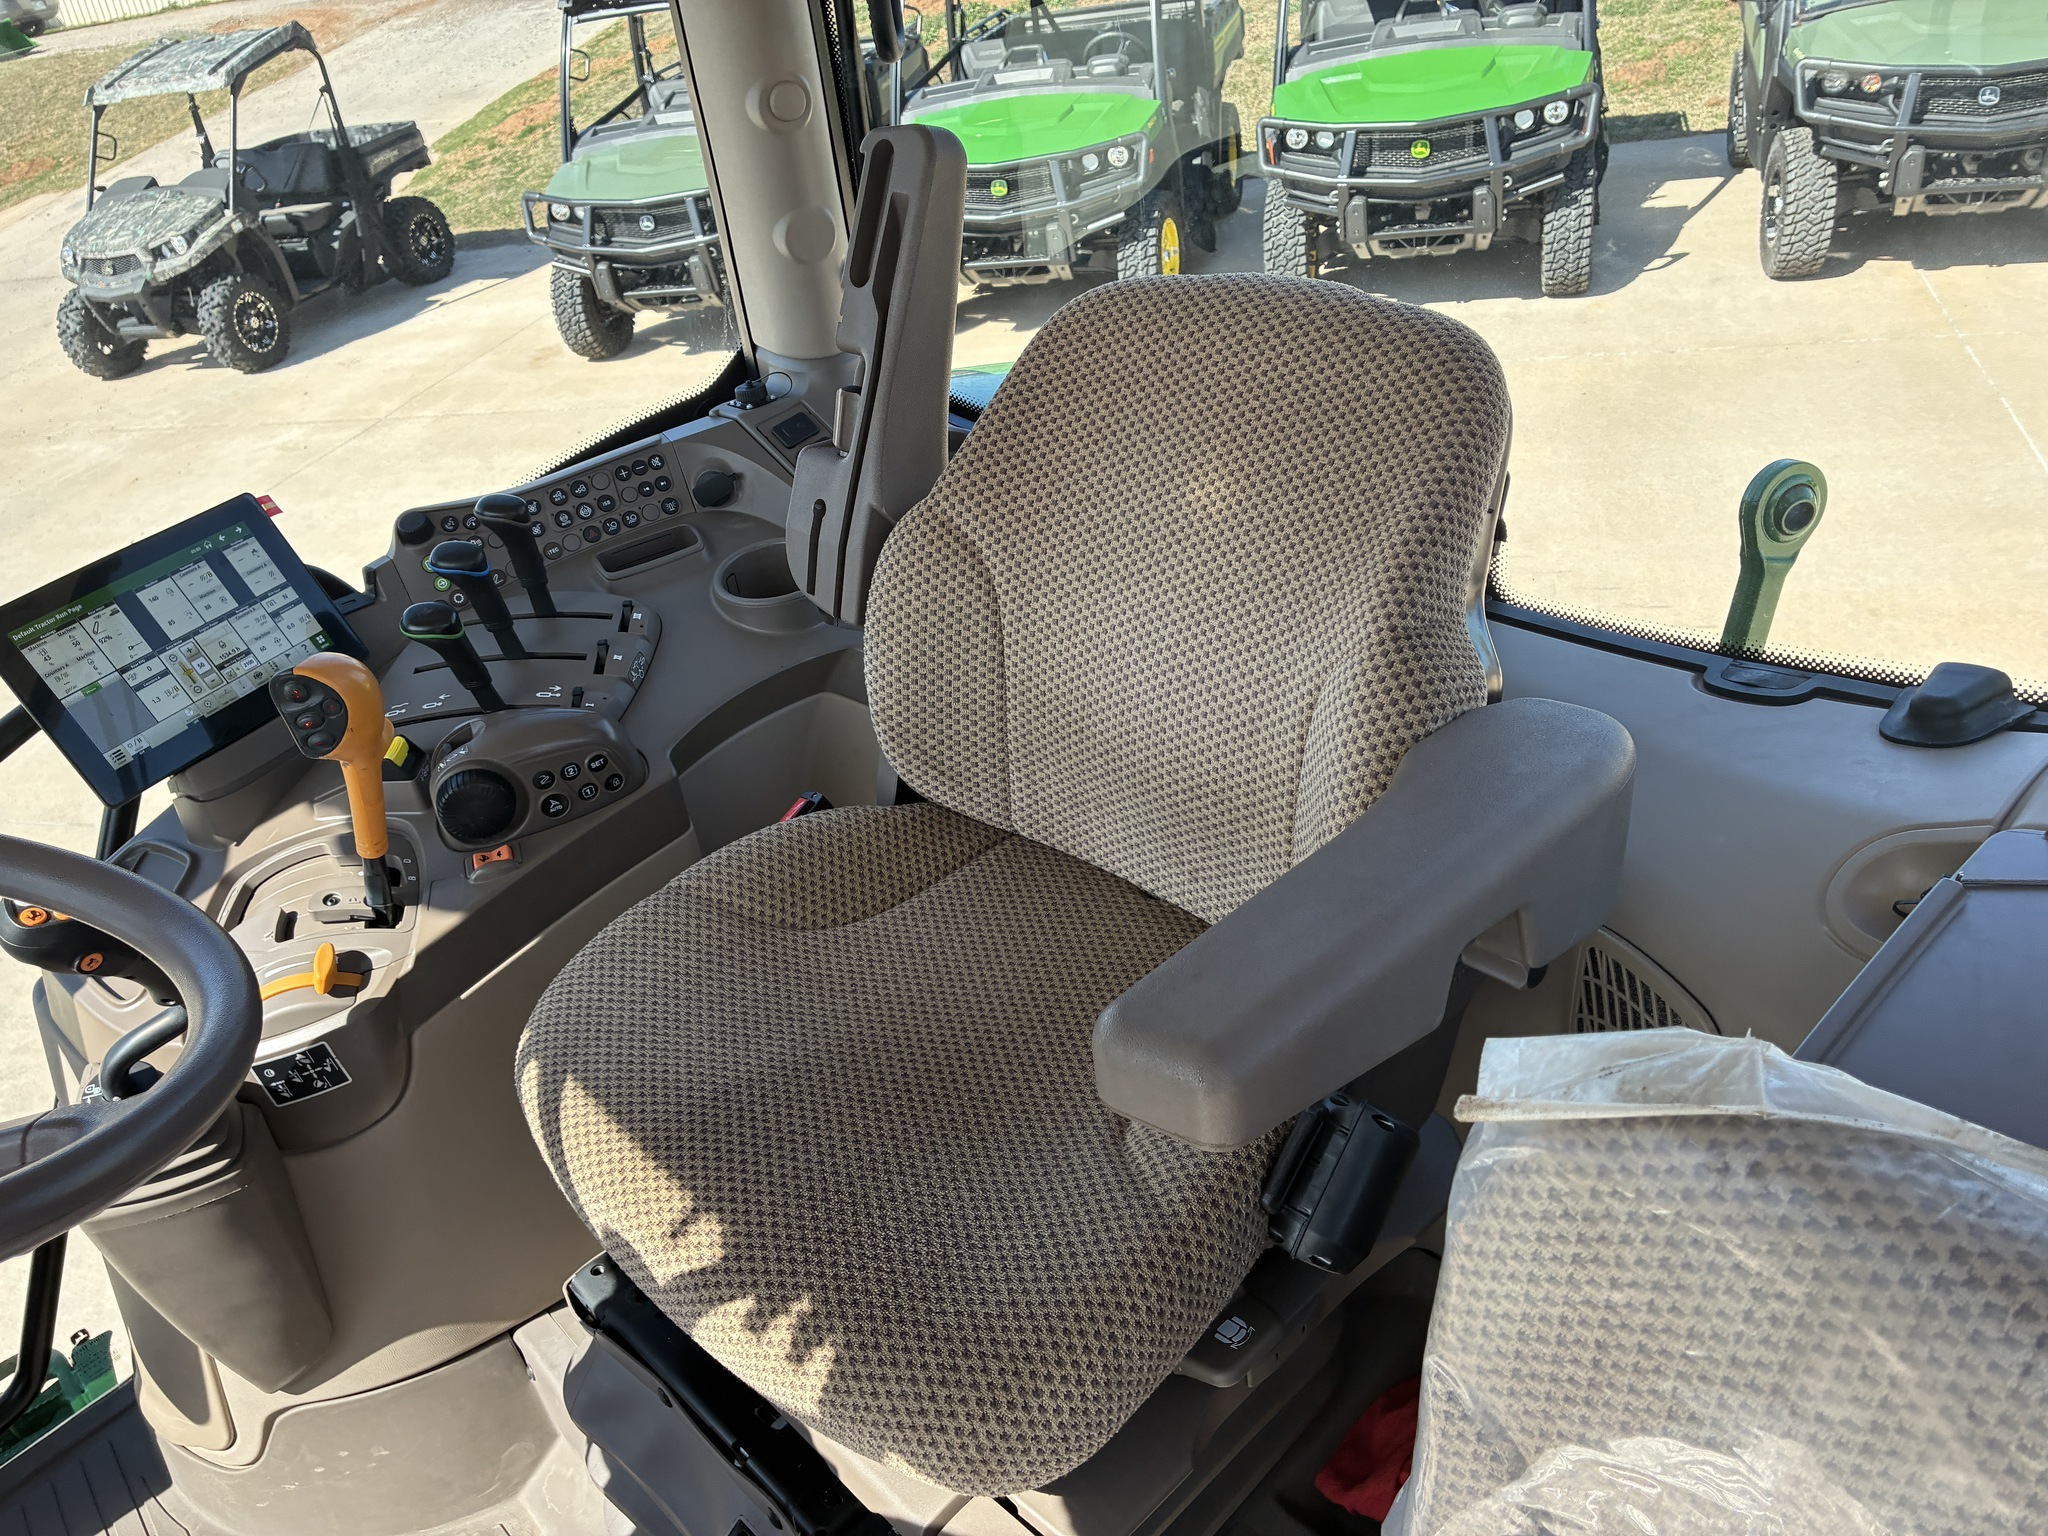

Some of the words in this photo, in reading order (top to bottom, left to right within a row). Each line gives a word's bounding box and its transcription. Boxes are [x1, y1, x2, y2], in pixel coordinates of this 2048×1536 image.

[149, 595, 160, 603] 140
[12, 627, 35, 641] Default
[35, 617, 57, 630] Tractor
[56, 612, 69, 620] Run
[68, 604, 84, 615] Page
[57, 626, 76, 637] Machine
[72, 640, 81, 648] 50
[98, 635, 113, 645] 92%
[27, 640, 47, 652] Machine
[76, 650, 95, 661] Machine
[219, 649, 237, 661] 1534.9
[44, 665, 67, 679] Counters
[590, 758, 604, 768] SET
[550, 805, 563, 813] AUTO
